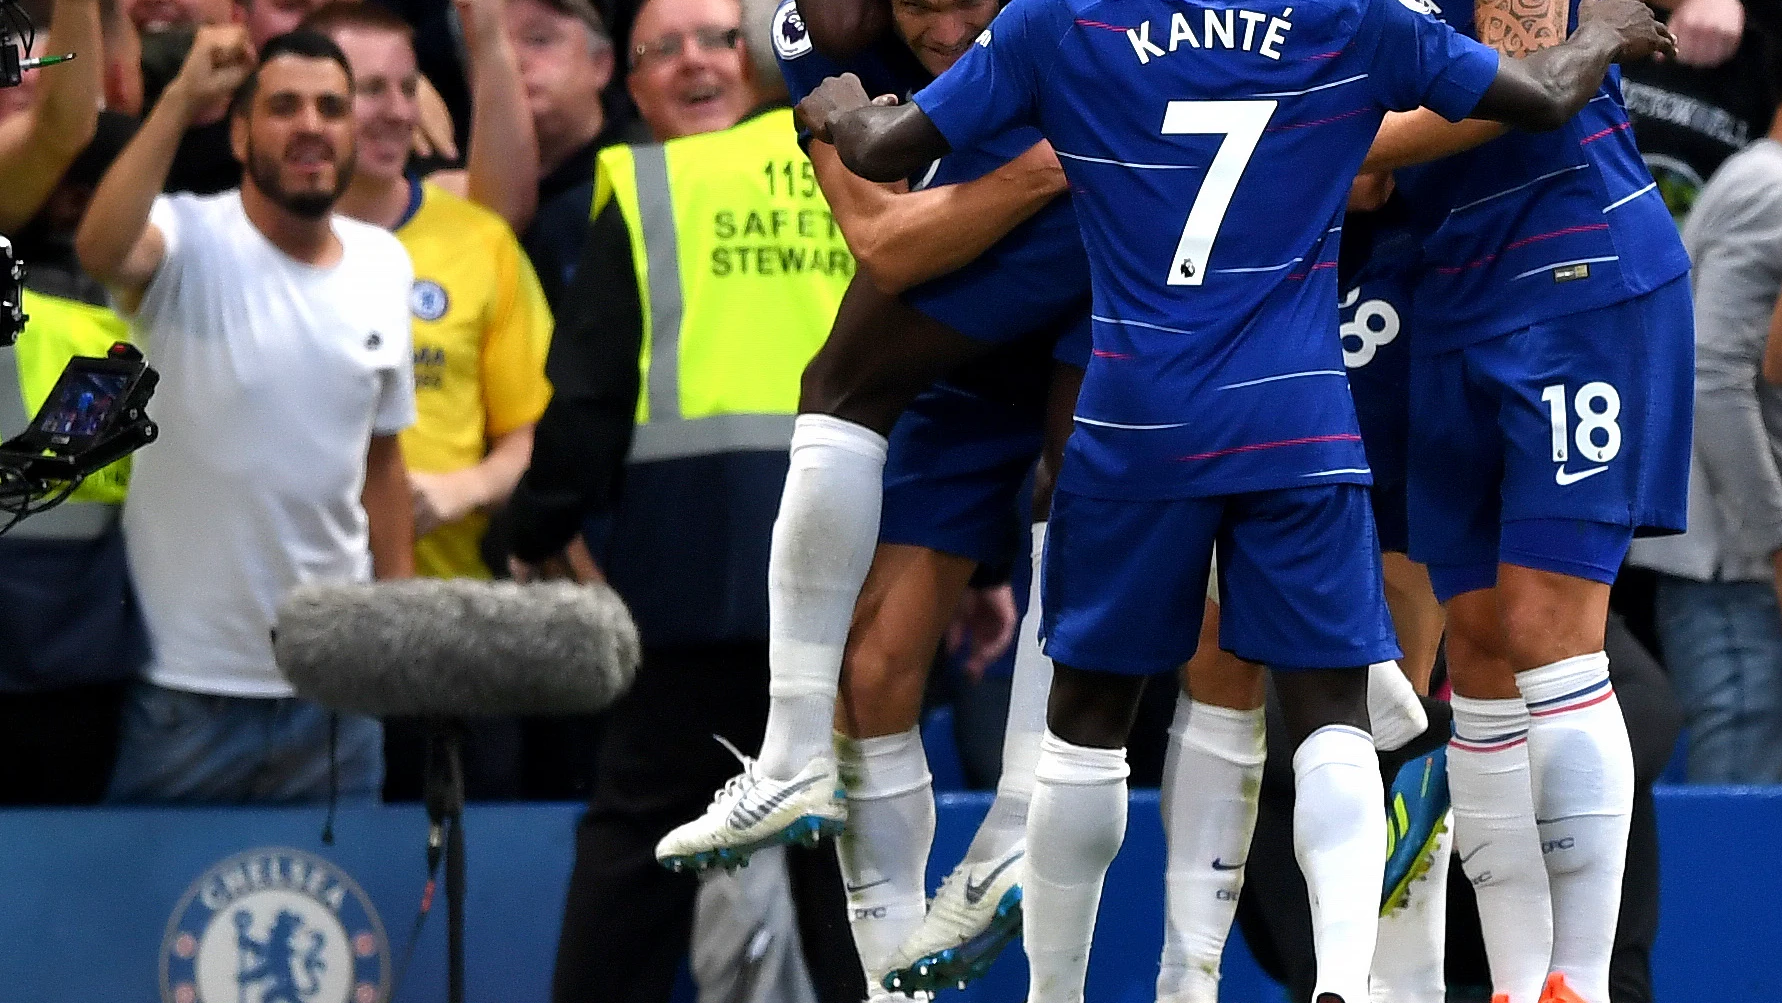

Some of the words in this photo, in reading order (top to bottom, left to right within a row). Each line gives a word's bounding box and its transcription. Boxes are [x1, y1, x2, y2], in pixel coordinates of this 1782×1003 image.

[1127, 7, 1292, 64] KANTÉ
[764, 160, 816, 198] 115
[1161, 100, 1278, 285] 7
[714, 209, 837, 240] SAFET
[711, 246, 852, 278] STEWAR
[1338, 287, 1400, 369] 8
[1541, 382, 1621, 462] 18
[200, 855, 346, 911] CHELSEA
